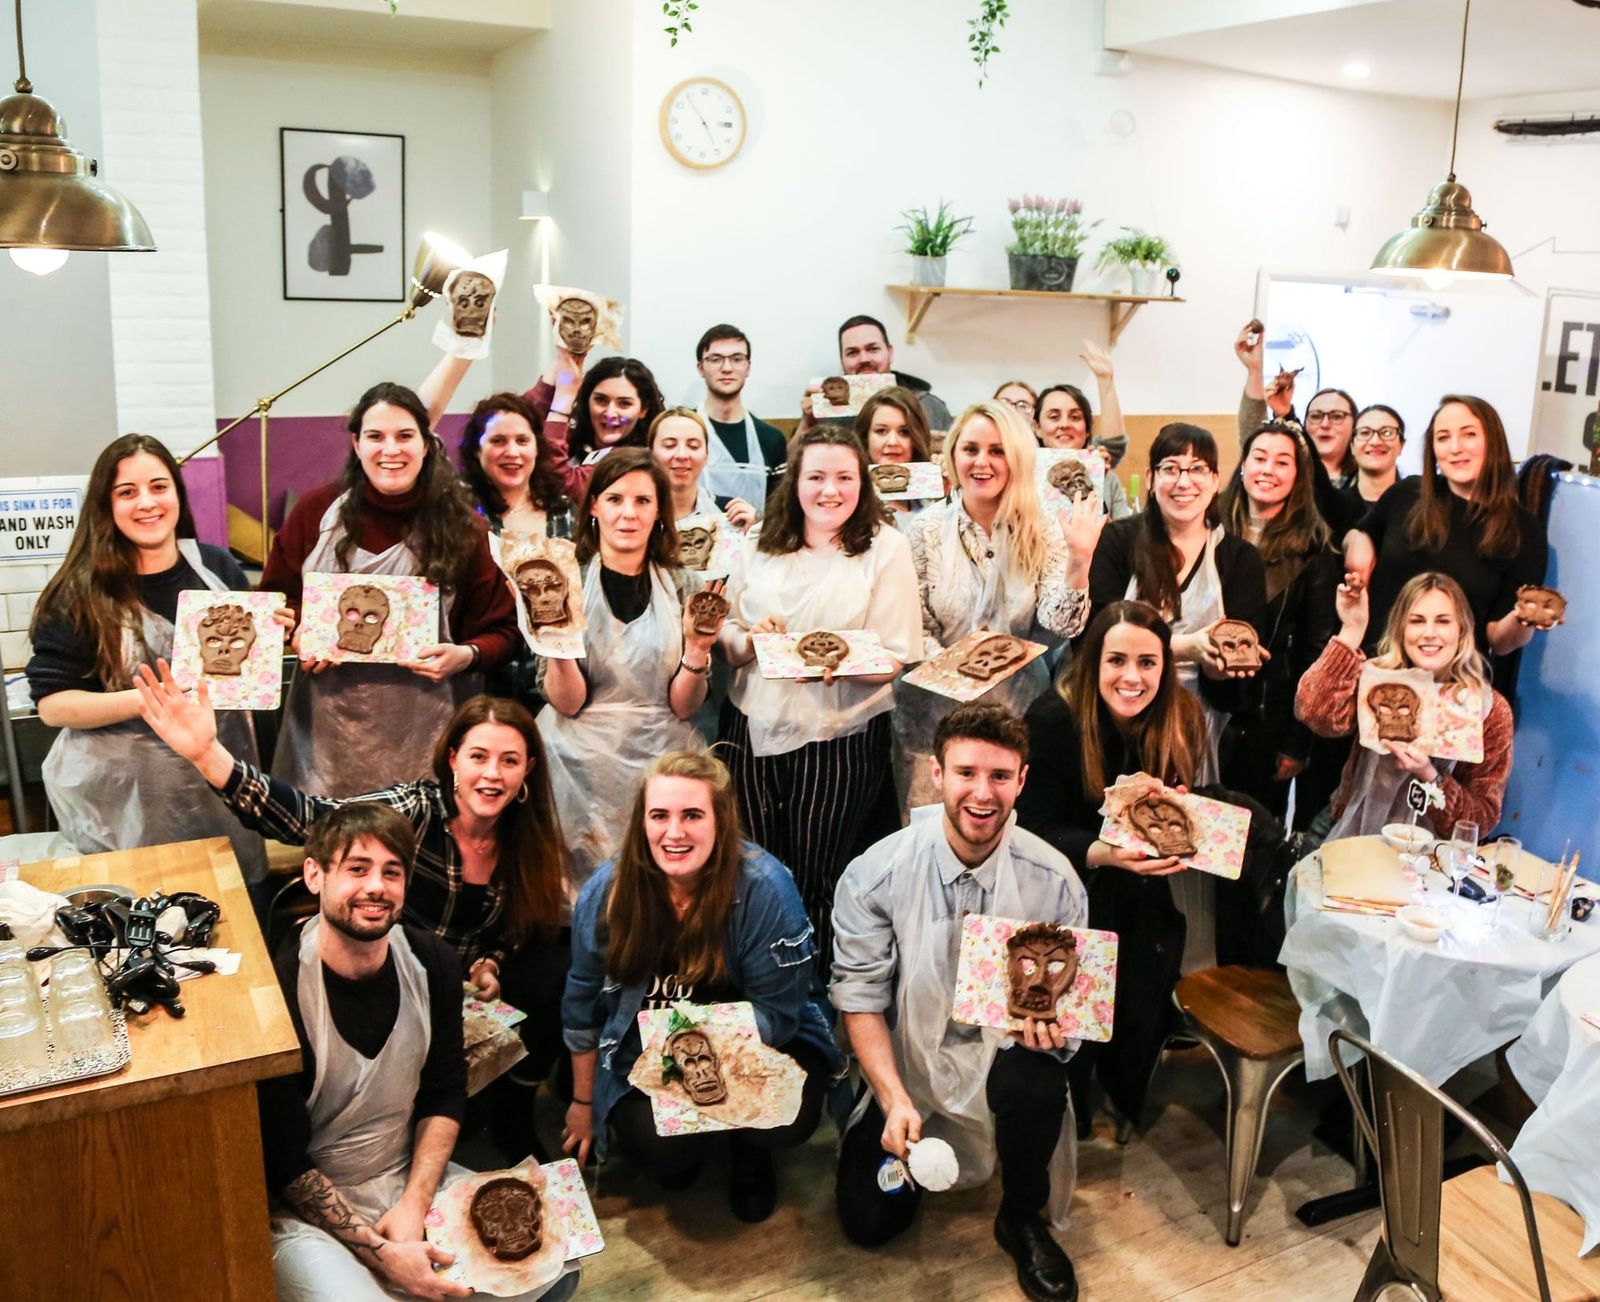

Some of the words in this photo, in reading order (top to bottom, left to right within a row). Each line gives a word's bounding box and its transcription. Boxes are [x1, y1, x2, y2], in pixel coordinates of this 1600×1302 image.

[13, 499, 36, 511] SINK
[40, 498, 49, 510] IS
[53, 498, 73, 509] FOR
[33, 515, 75, 530] WASH
[15, 535, 50, 550] ONLY
